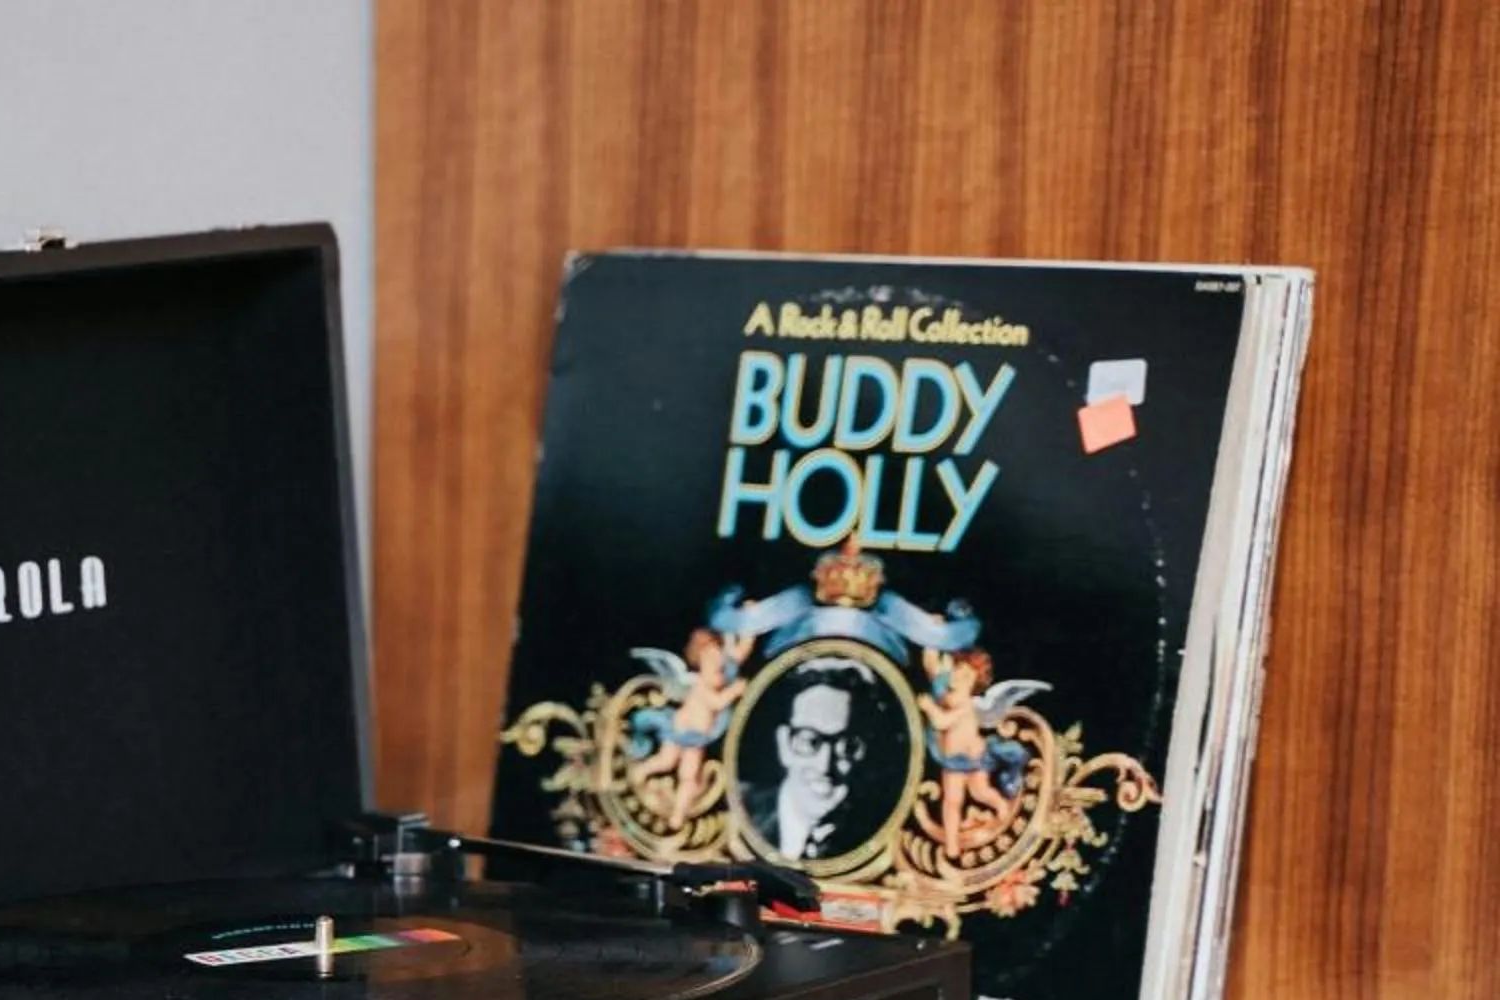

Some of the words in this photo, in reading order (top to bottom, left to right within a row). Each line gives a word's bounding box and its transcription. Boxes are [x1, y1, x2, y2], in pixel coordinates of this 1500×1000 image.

[743, 301, 775, 336] A
[778, 302, 834, 339] Rock
[860, 305, 909, 341] Roll
[909, 306, 1030, 346] Collection
[730, 350, 1016, 455] BUDDY
[717, 446, 999, 551] HOLLY
